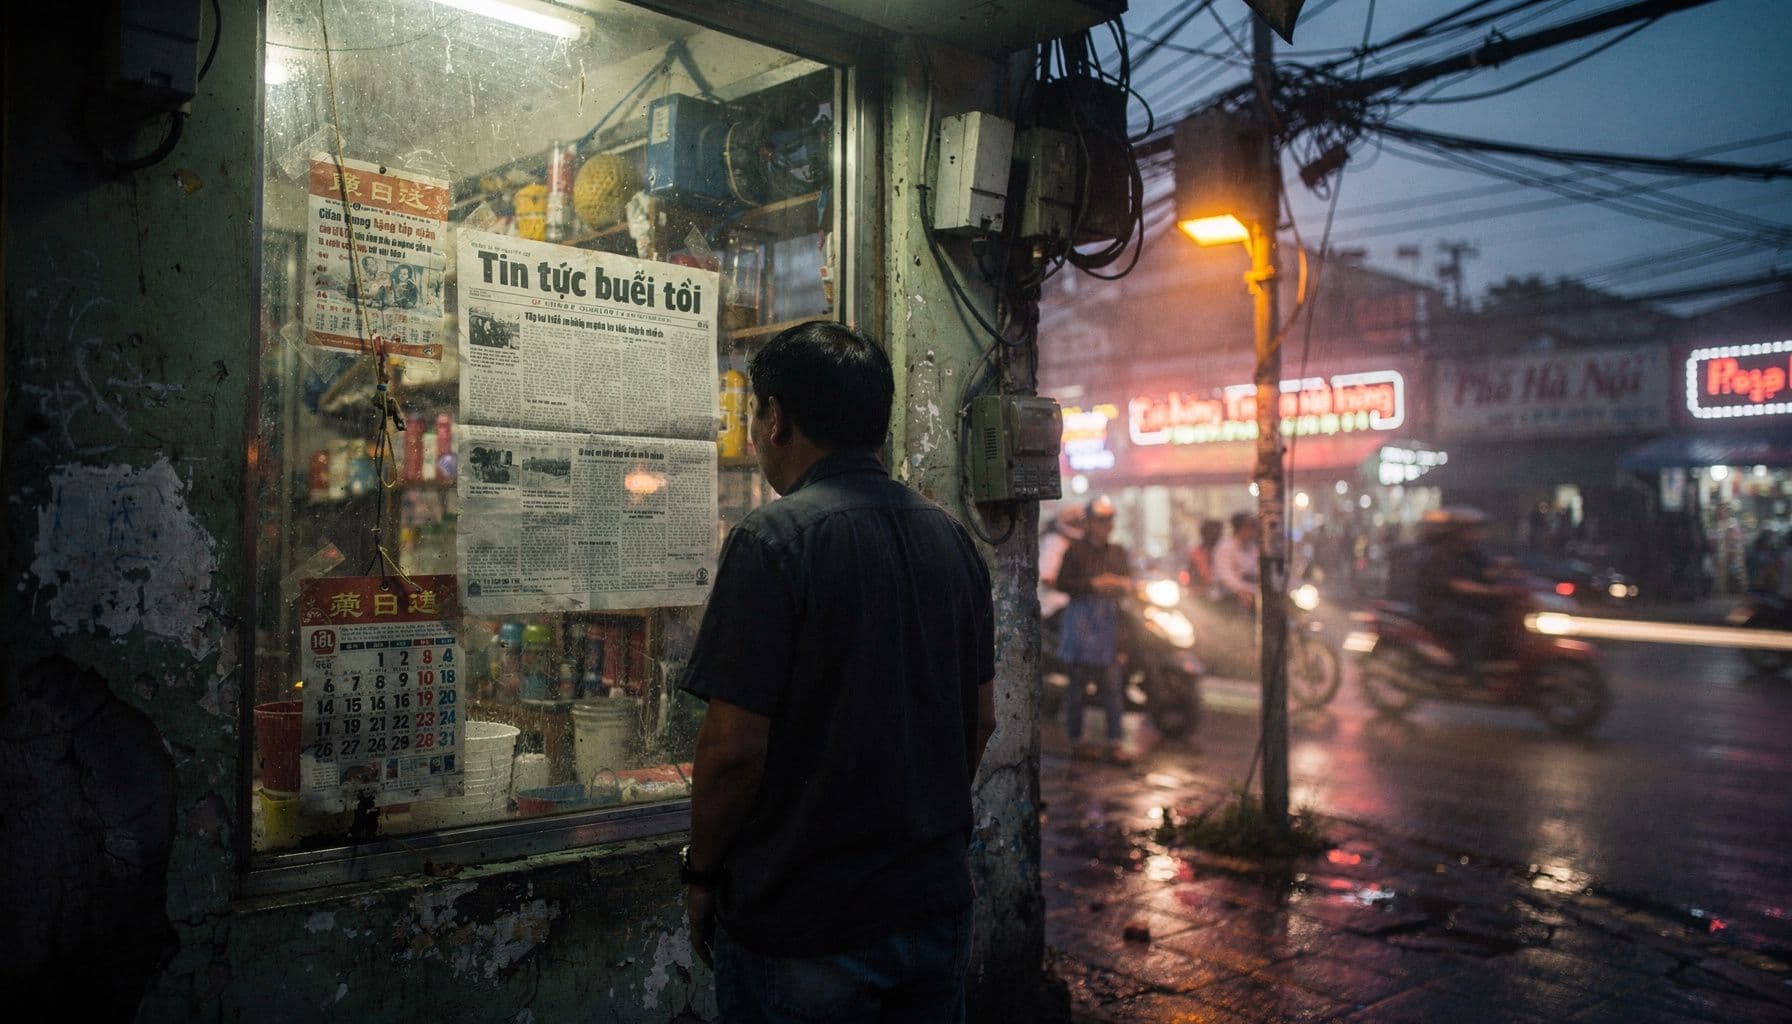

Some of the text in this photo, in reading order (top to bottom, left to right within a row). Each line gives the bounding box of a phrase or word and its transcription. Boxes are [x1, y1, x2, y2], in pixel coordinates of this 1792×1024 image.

[478, 250, 529, 290] Tin
[537, 262, 587, 300] tức
[663, 278, 701, 314] tồi
[377, 652, 384, 667] 1
[400, 651, 409, 666] 2
[443, 648, 453, 662] 4
[324, 670, 455, 693] 6 7 8 9 10 18
[346, 698, 361, 712] 15
[370, 696, 385, 710] 16
[417, 692, 433, 706] 19
[439, 690, 456, 704] 20
[344, 719, 360, 734] 19
[369, 717, 385, 732] 21
[392, 715, 409, 729] 22
[416, 713, 434, 727] 23
[341, 740, 360, 755] 27
[416, 733, 434, 748] 28
